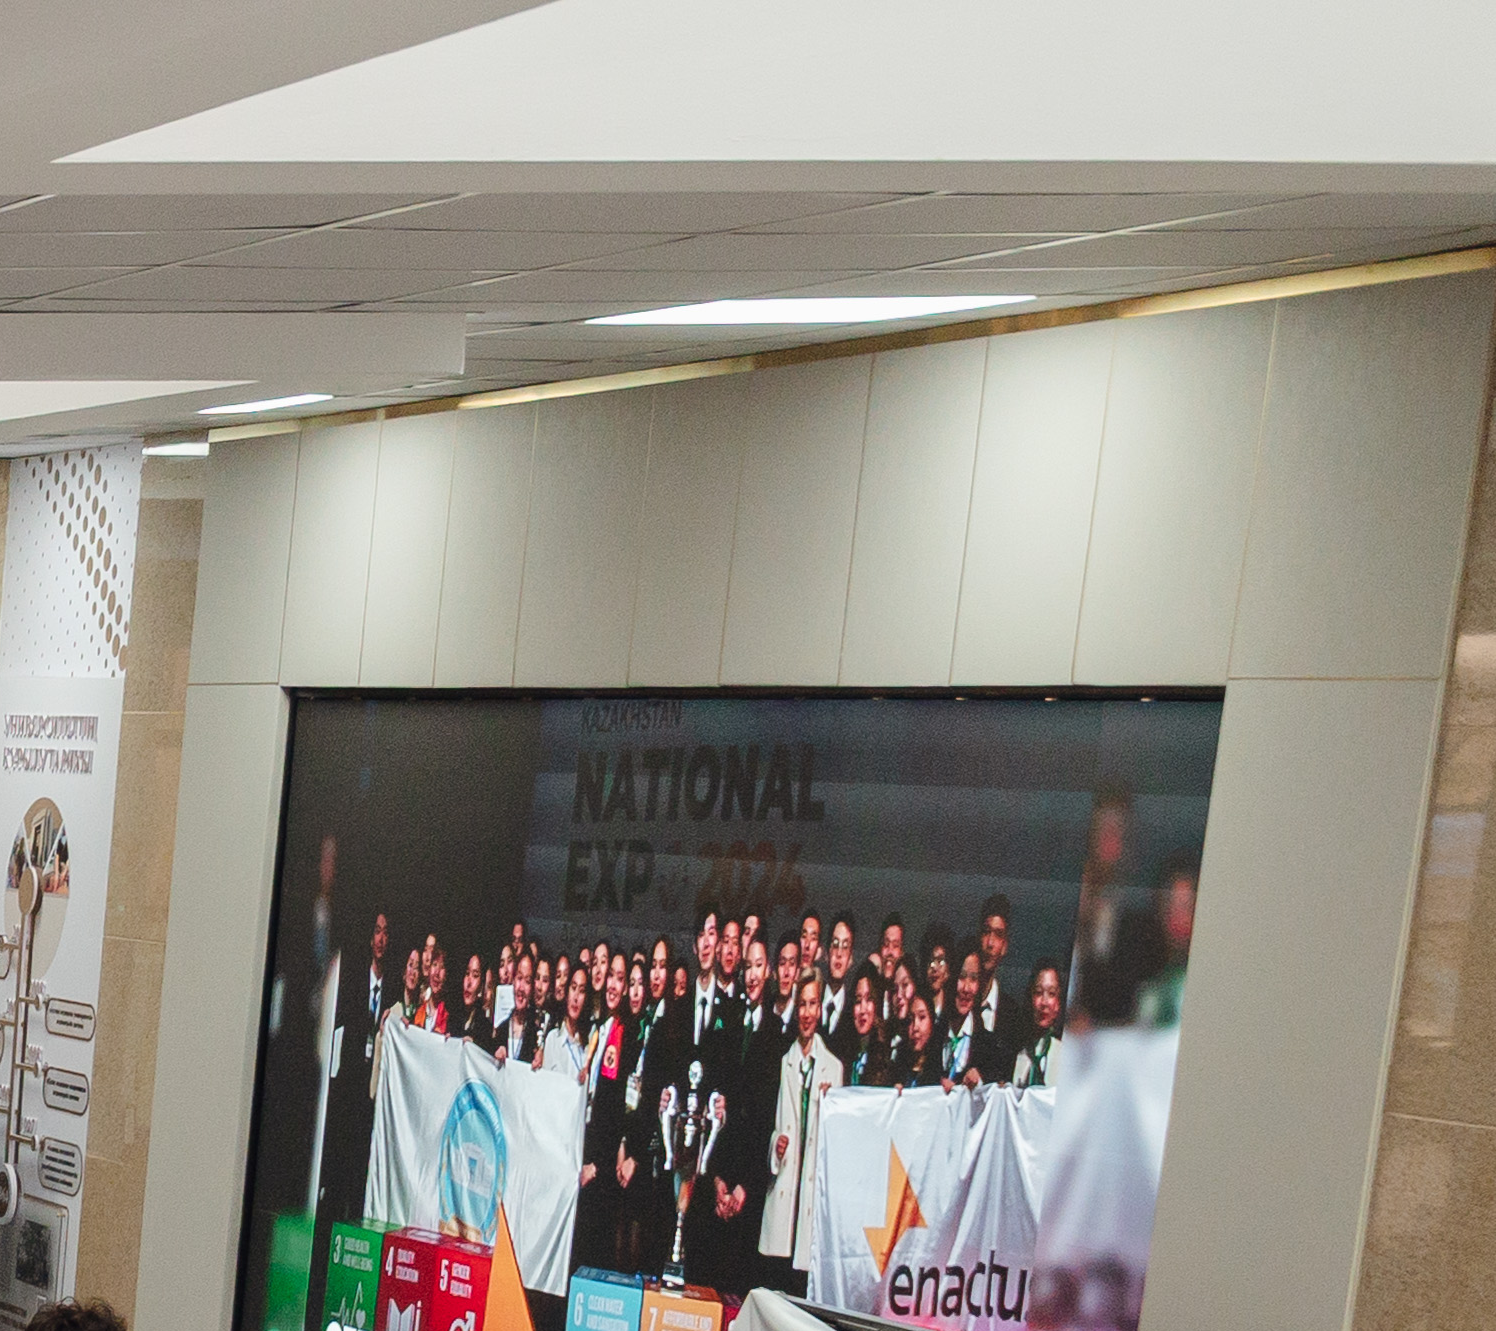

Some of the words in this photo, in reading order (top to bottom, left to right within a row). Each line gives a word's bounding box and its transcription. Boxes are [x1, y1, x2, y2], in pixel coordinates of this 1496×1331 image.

[571, 743, 825, 822] NATIONAL
[333, 1234, 342, 1264] 3
[385, 1246, 395, 1277] 4
[439, 1258, 449, 1292] 5
[888, 1250, 1029, 1323] enactu
[574, 1291, 585, 1327] 6
